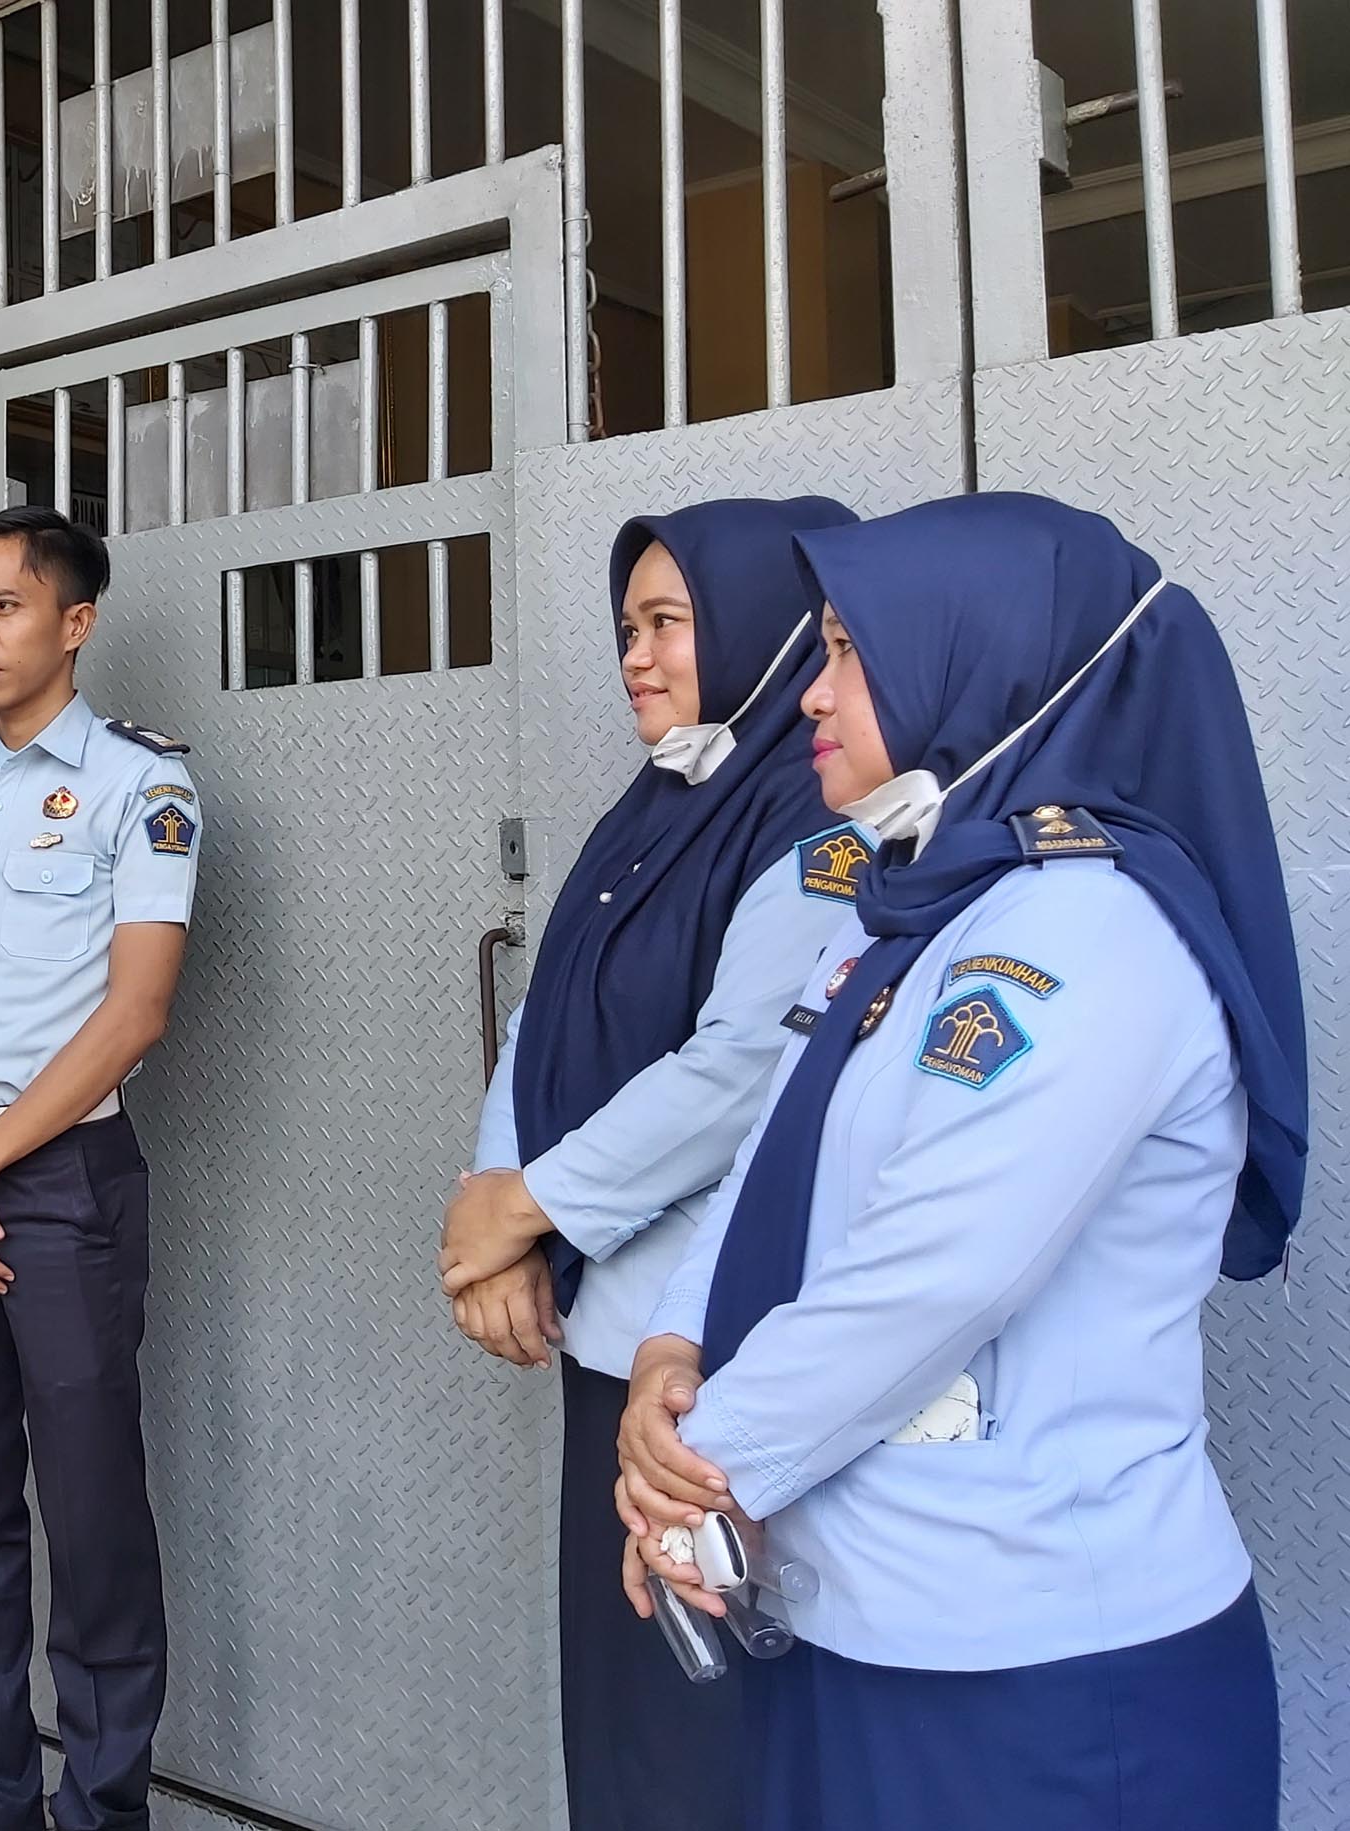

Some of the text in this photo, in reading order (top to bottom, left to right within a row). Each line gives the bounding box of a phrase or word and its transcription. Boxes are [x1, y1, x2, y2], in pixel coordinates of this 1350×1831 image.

[804, 877, 856, 896] PENGAYOM
[952, 956, 1053, 993] KEMENKUMHAM
[921, 1054, 985, 1083] PENGAYOMAN
